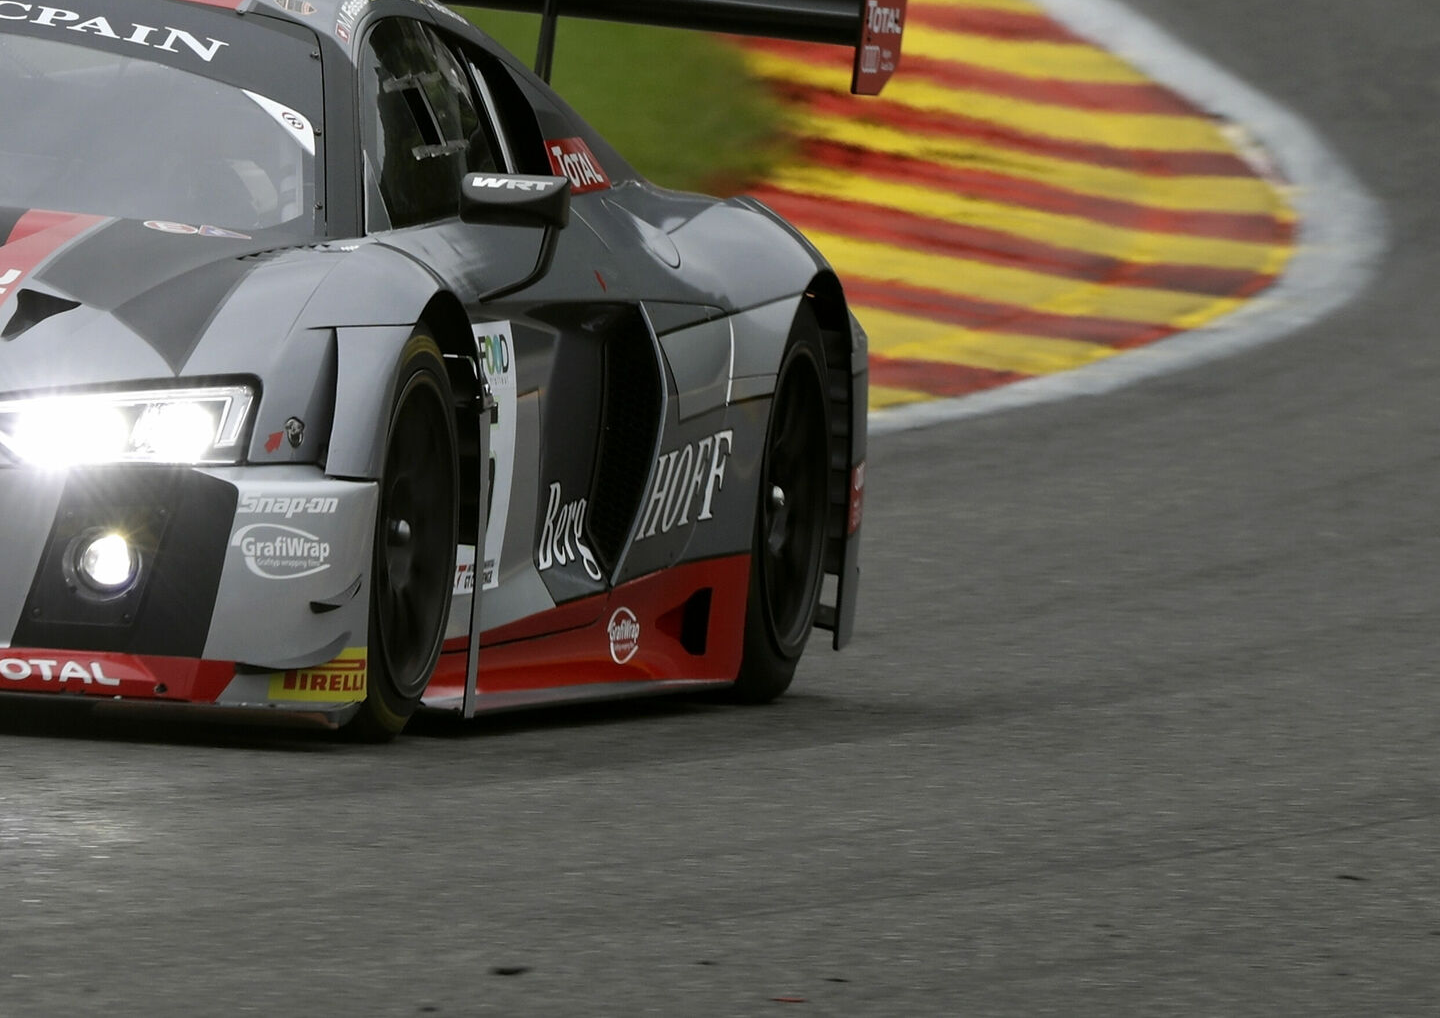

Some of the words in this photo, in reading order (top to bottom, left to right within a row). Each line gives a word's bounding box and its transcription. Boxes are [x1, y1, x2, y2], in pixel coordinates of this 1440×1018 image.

[868, 0, 902, 35] TOTAL
[472, 176, 554, 191] WRT
[551, 146, 604, 188] TOTAL
[236, 491, 339, 518] Snap-on
[539, 481, 602, 581] Berg
[635, 429, 733, 542] HOFF
[241, 536, 330, 562] GrafiWrap
[283, 659, 366, 692] PIRELLI
